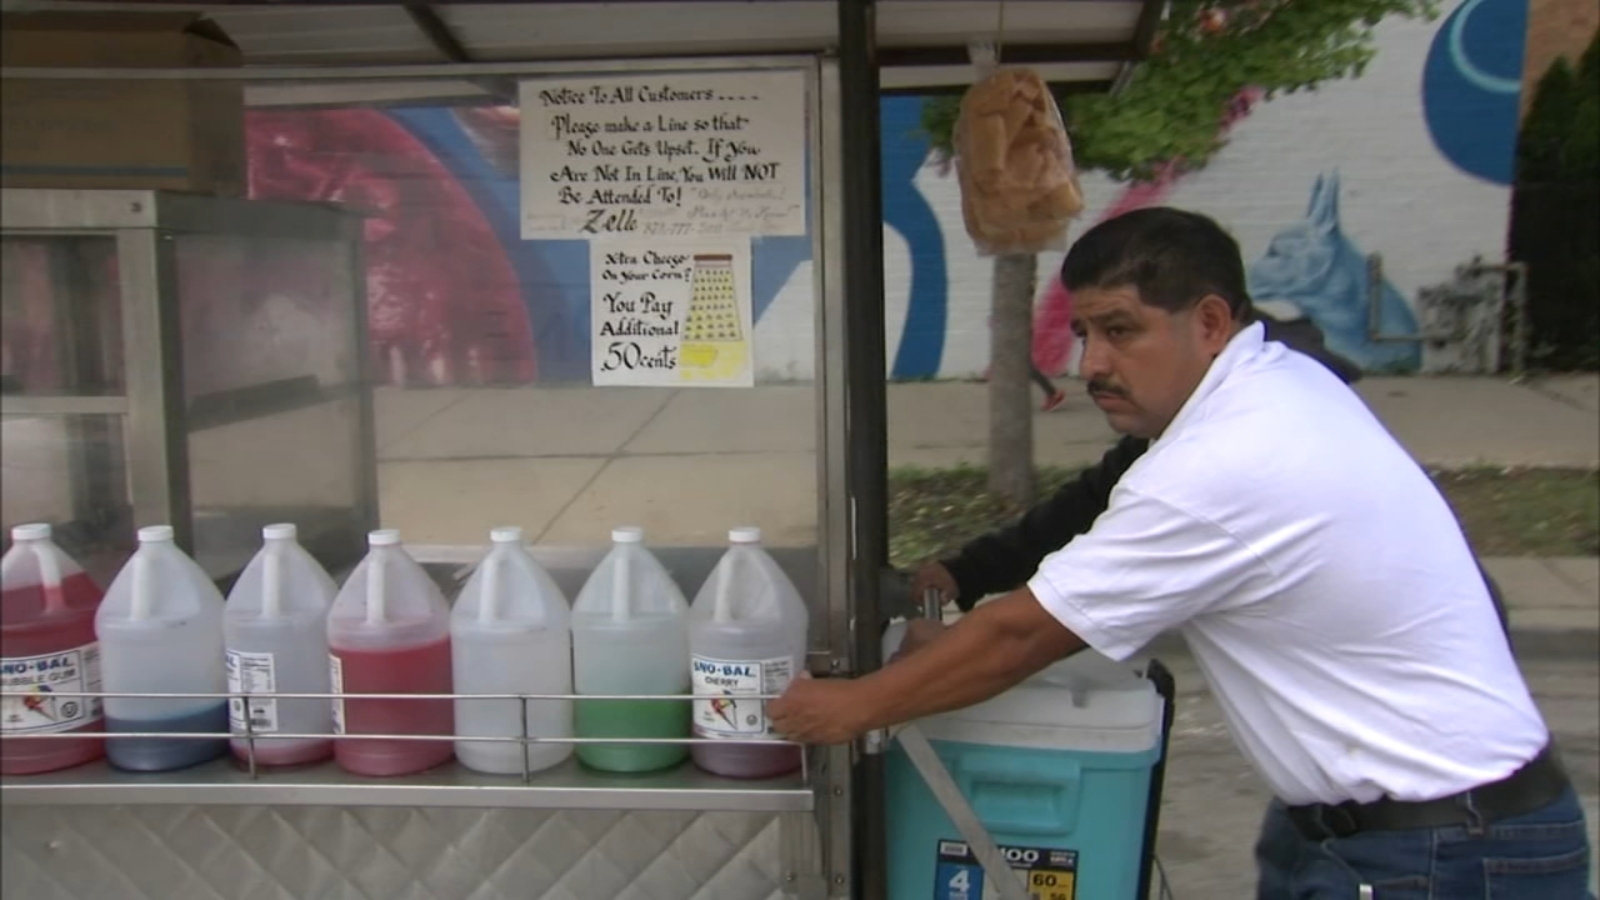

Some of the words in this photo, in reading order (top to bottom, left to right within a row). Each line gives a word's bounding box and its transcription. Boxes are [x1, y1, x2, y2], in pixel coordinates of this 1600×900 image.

[539, 88, 585, 106] Notice
[590, 85, 608, 103] To
[610, 86, 633, 103] All
[638, 85, 714, 103] Customers
[551, 113, 600, 139] Please
[605, 116, 640, 132] make
[658, 114, 688, 132] Line
[712, 113, 748, 131] that
[568, 140, 587, 156] No
[595, 139, 615, 156] One
[621, 140, 650, 156] Gets
[702, 137, 721, 162] If
[724, 139, 761, 162] You
[550, 165, 588, 182] Are
[595, 164, 620, 182] Not
[623, 165, 641, 182] In
[680, 166, 704, 183] You
[708, 165, 737, 182] Will
[741, 162, 781, 181] NOT
[558, 186, 583, 204] Be
[586, 184, 653, 205] Attended
[656, 186, 682, 207] To!
[579, 208, 638, 234] Zelle
[605, 252, 638, 266] Xtra
[602, 269, 618, 281] On
[619, 270, 649, 285] Your
[652, 267, 692, 283] Corn?
[603, 292, 636, 313] You
[640, 291, 673, 320] Pay
[599, 316, 679, 337] Additional
[0, 657, 75, 675] NO-BAL
[948, 869, 971, 892] 4
[1033, 874, 1057, 887] 60
